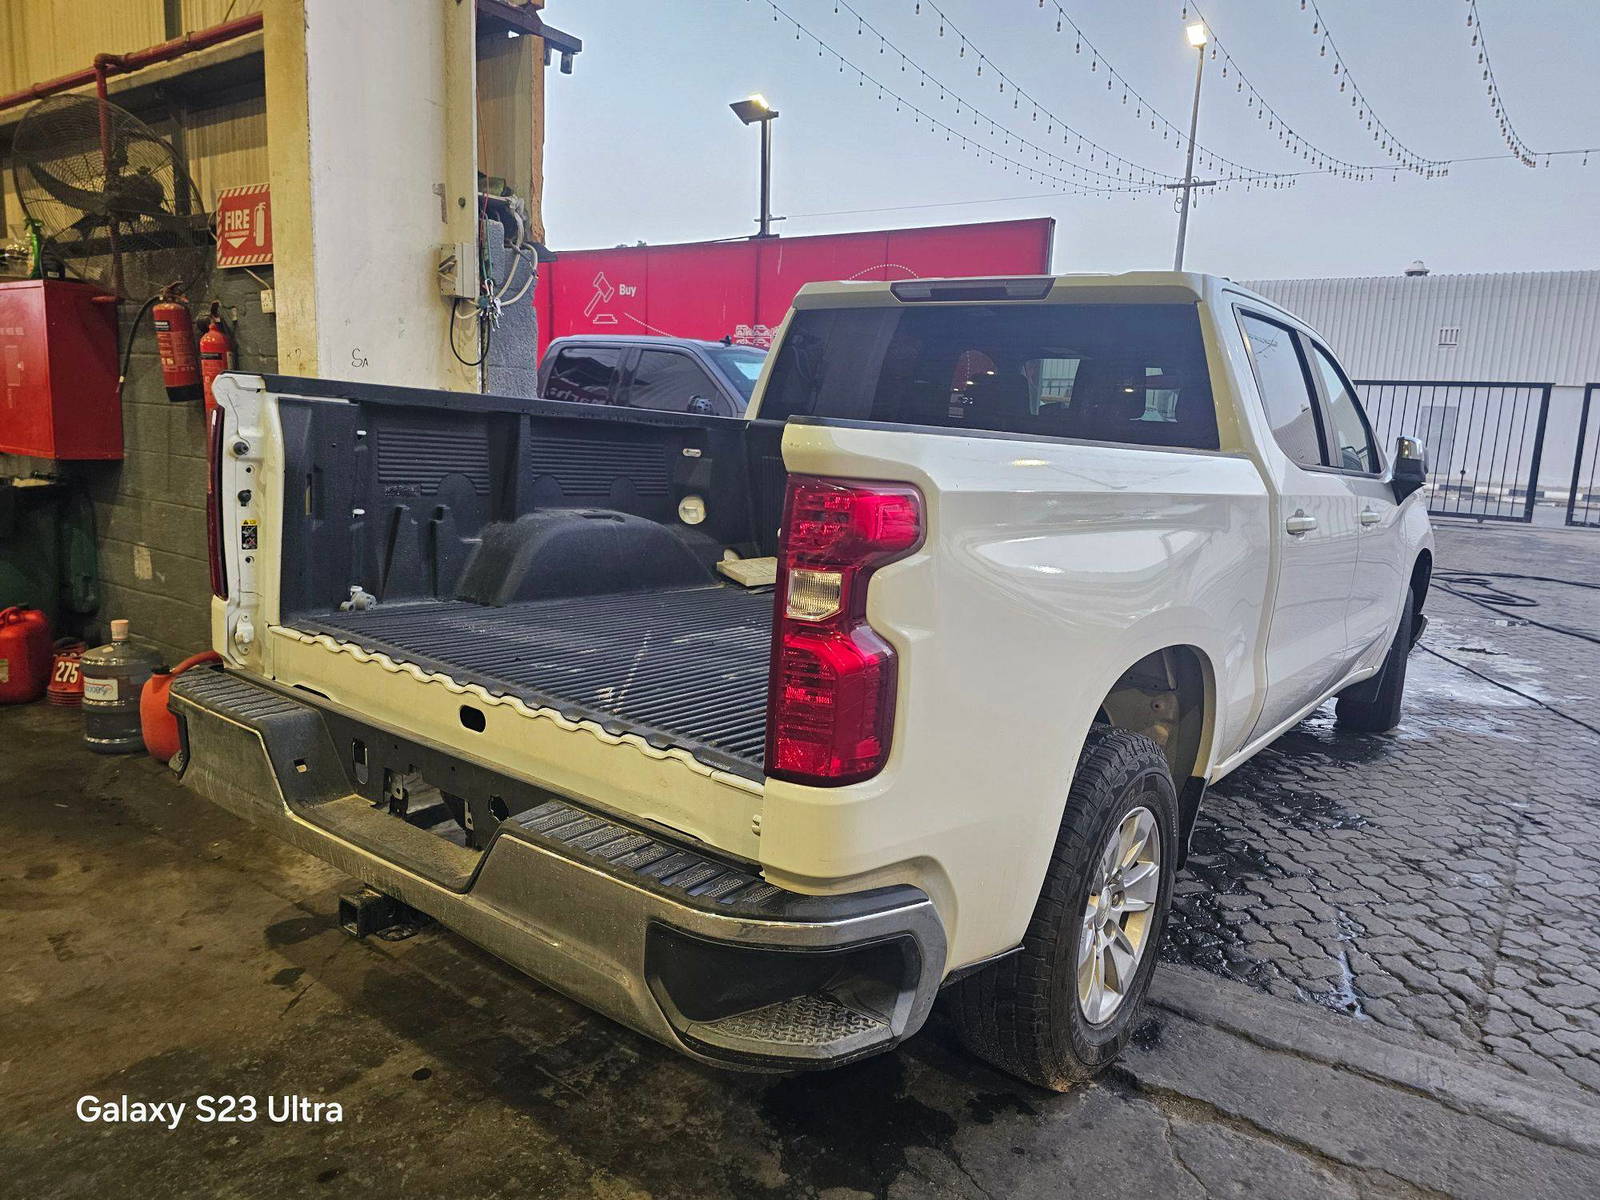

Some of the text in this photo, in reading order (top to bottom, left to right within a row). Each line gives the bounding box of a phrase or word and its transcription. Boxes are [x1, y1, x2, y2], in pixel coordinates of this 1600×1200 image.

[224, 208, 250, 231] FIRE
[619, 284, 636, 297] Buy
[55, 661, 80, 684] 275
